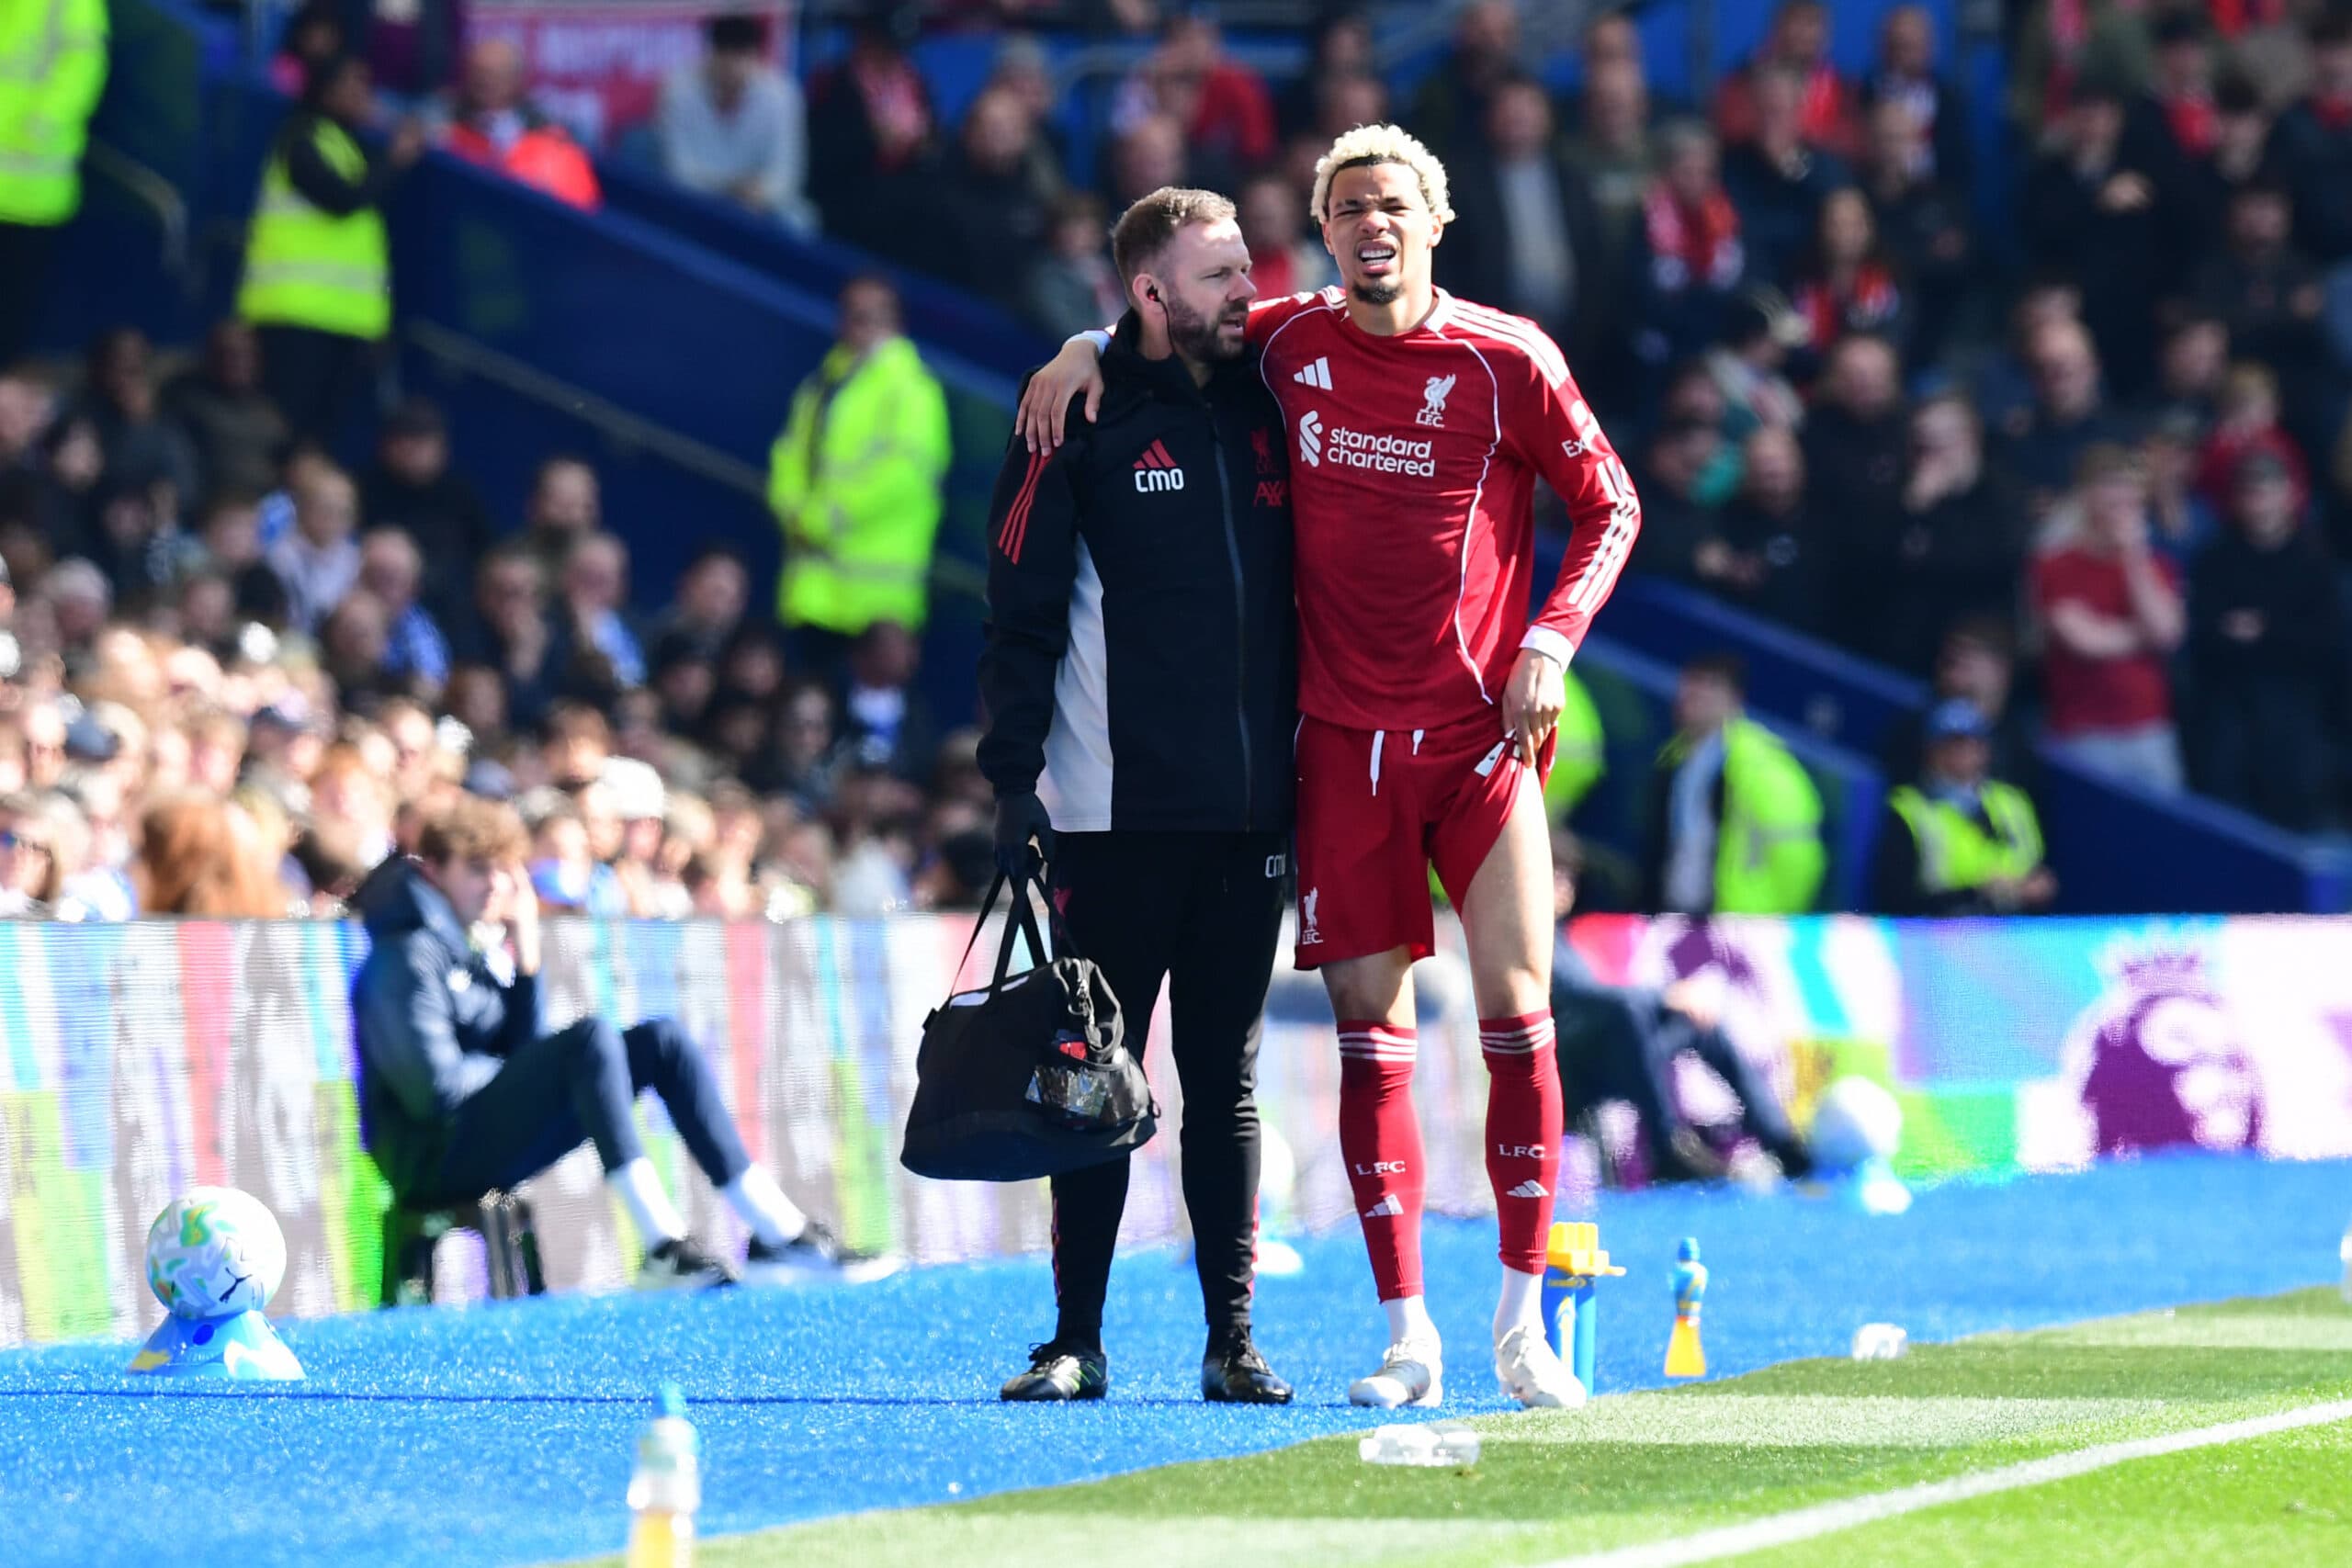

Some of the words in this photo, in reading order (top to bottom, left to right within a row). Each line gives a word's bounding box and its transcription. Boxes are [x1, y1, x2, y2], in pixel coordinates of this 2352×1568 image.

[1329, 426, 1432, 459] standard
[1327, 446, 1435, 478] chartered
[1135, 468, 1184, 492] CMO
[1265, 852, 1286, 878] CM
[1498, 1144, 1545, 1159] LFC
[1355, 1160, 1406, 1176] LFC
